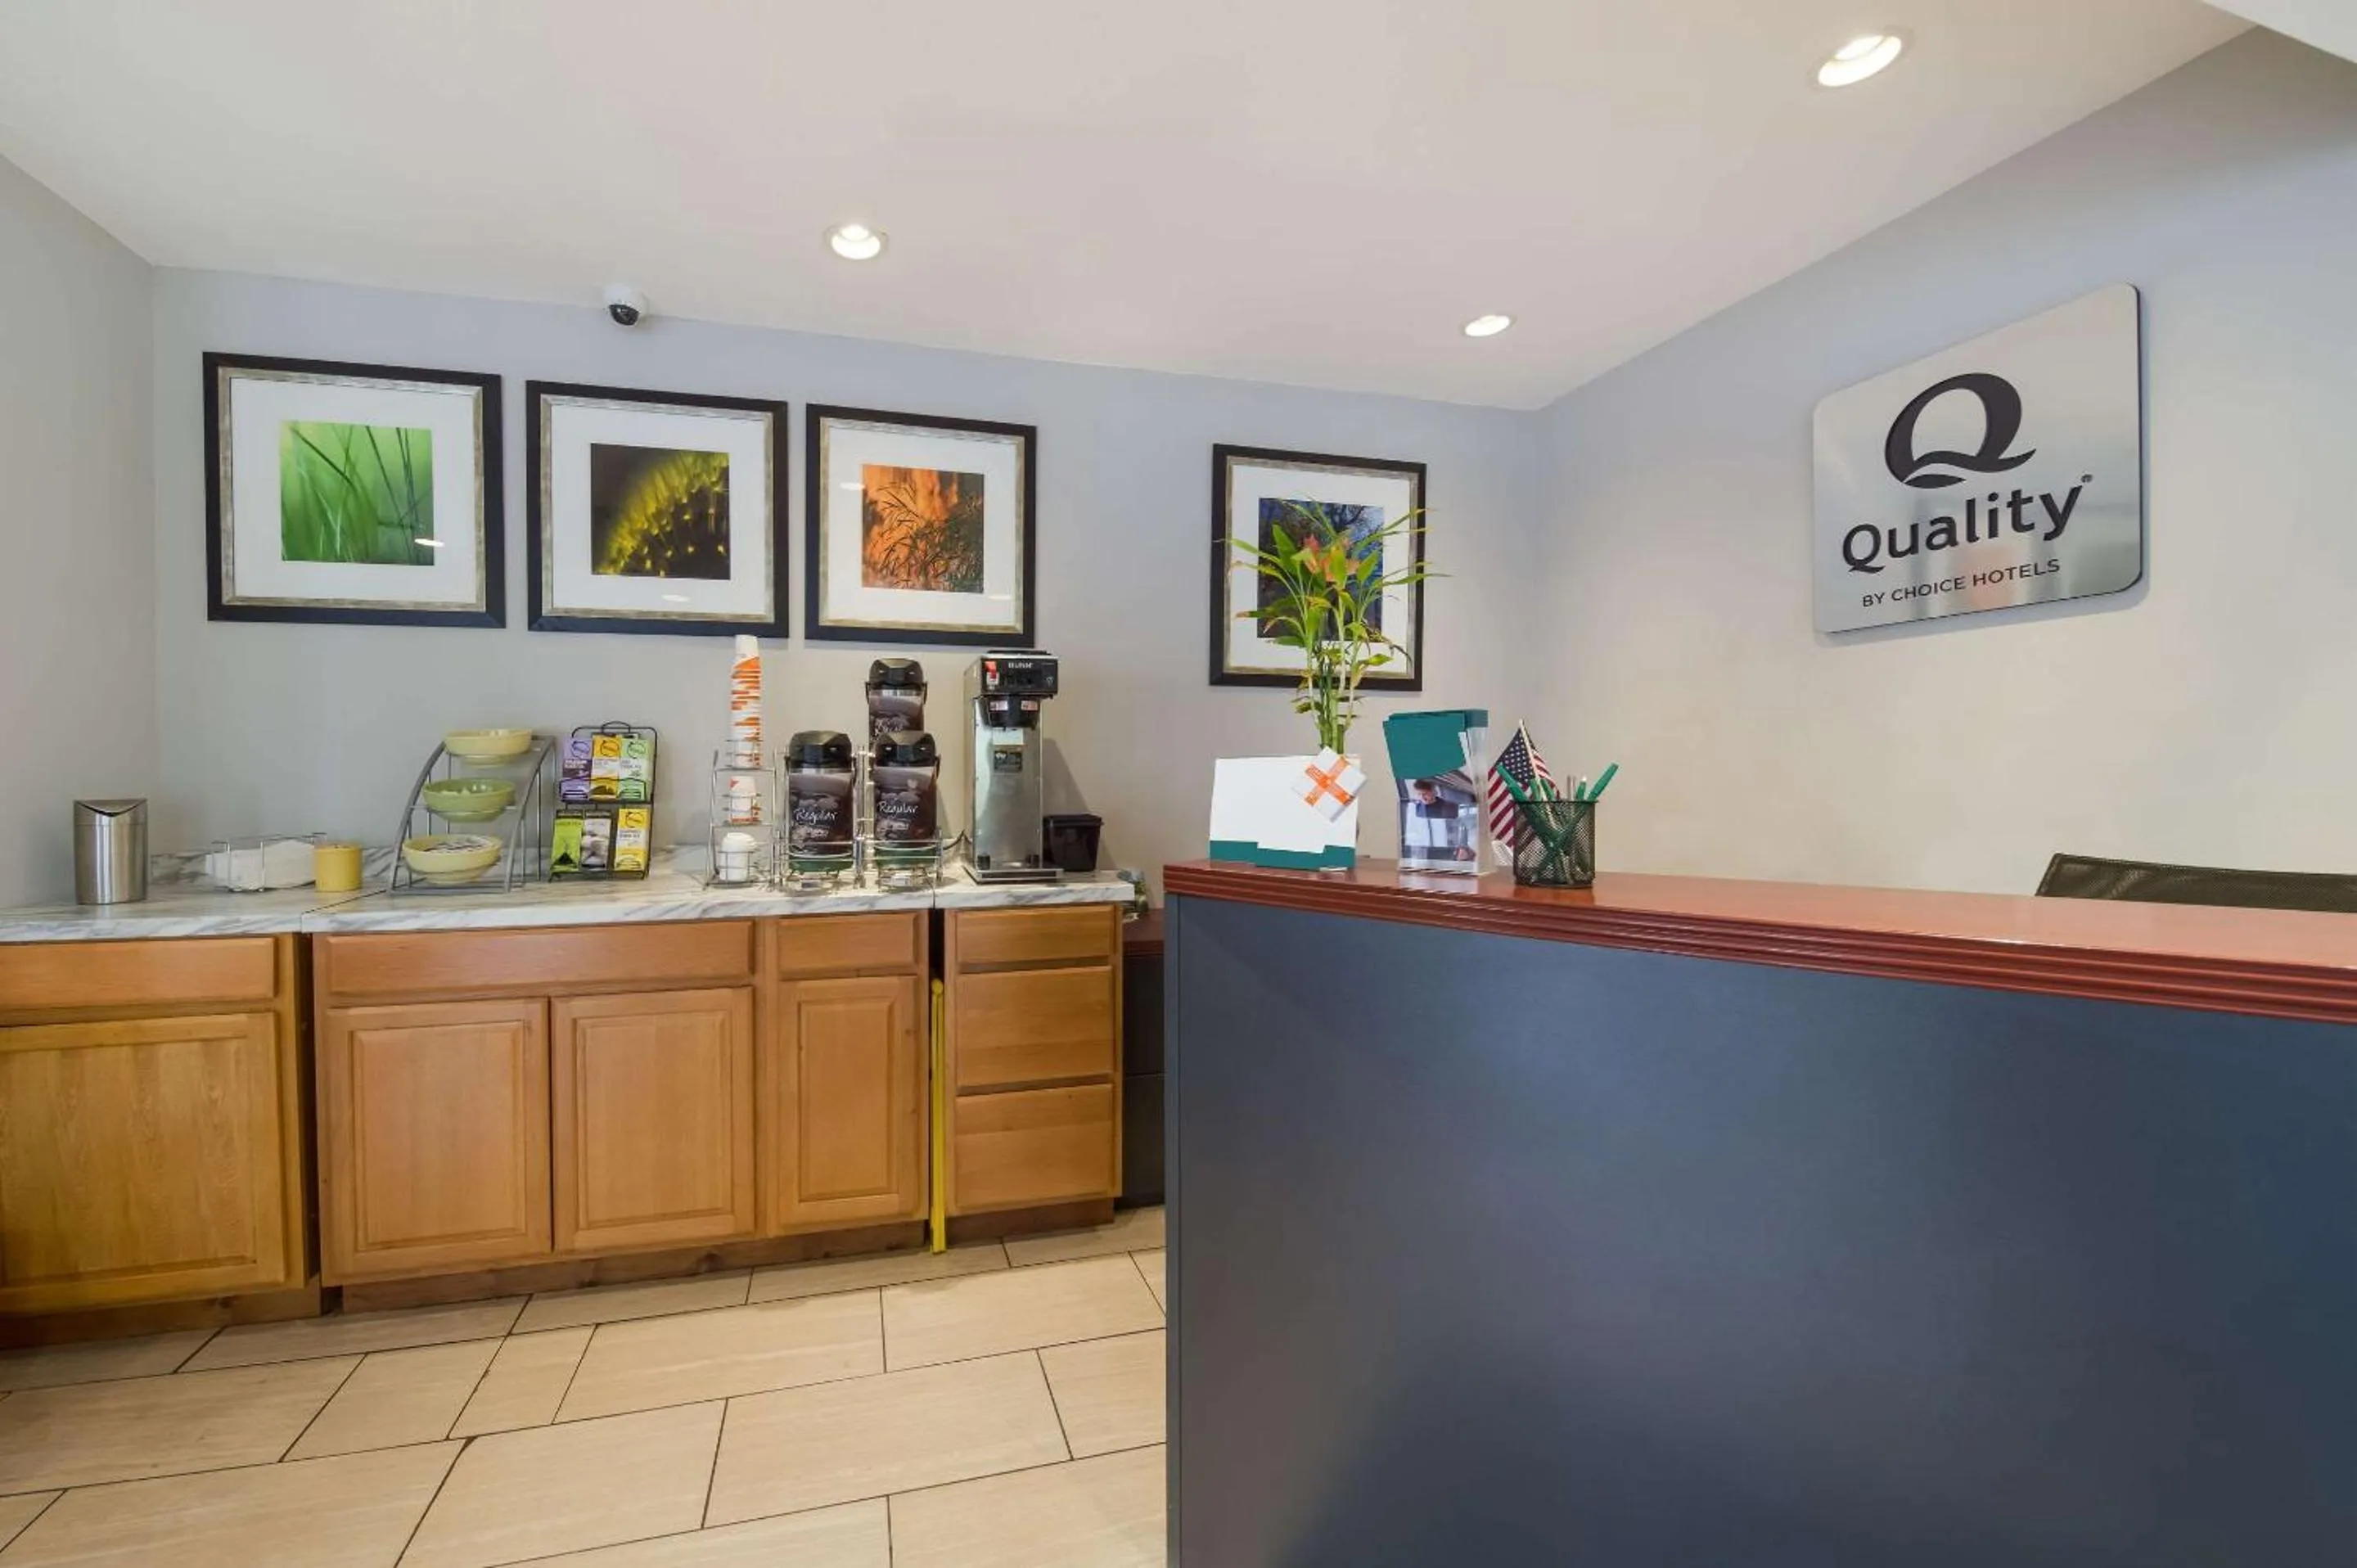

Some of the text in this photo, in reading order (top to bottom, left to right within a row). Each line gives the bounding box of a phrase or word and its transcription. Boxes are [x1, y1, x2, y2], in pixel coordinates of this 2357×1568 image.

[1841, 483, 2084, 574] Quality
[1862, 558, 2061, 607] BY CHOICE HOTELS
[794, 807, 838, 825] Regular
[877, 800, 918, 819] Regular
